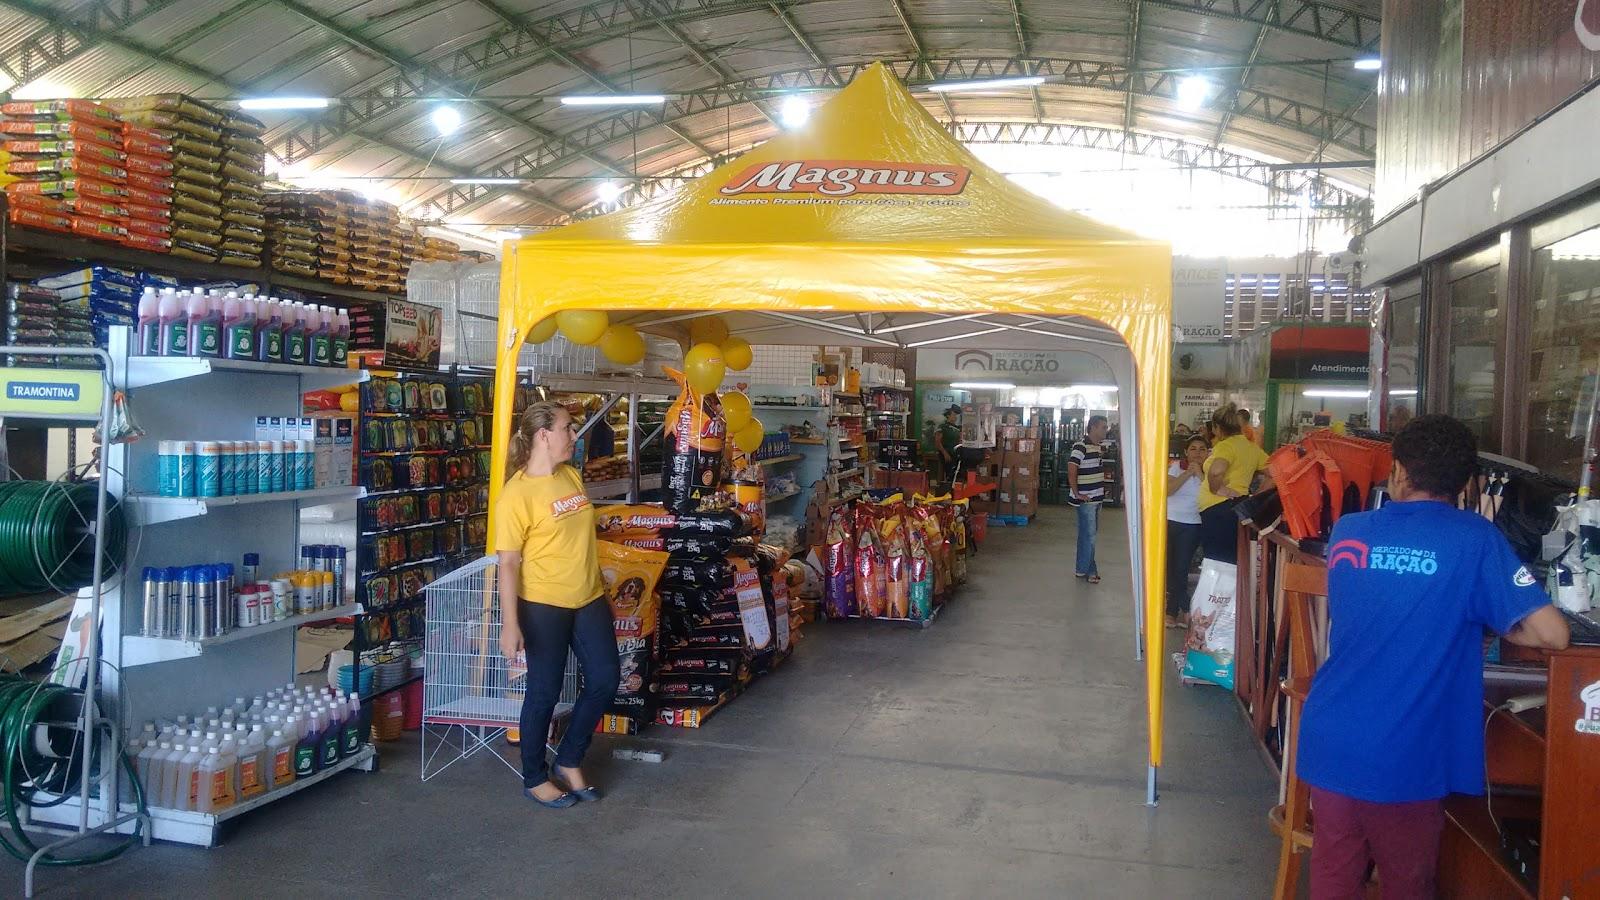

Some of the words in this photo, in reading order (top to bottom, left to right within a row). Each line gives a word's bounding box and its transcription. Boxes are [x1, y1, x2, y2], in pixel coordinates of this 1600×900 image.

[719, 160, 955, 195] Magnus
[1183, 325, 1220, 337] RAÇÃO
[995, 354, 1059, 375] RAÇÃO
[12, 385, 75, 398] TRAMONTINA
[626, 514, 673, 528] Magnus
[1372, 546, 1411, 554] MERCADO
[1423, 550, 1436, 559] DA
[1370, 550, 1438, 575] RAÇÃO
[628, 697, 645, 706] 25kg
